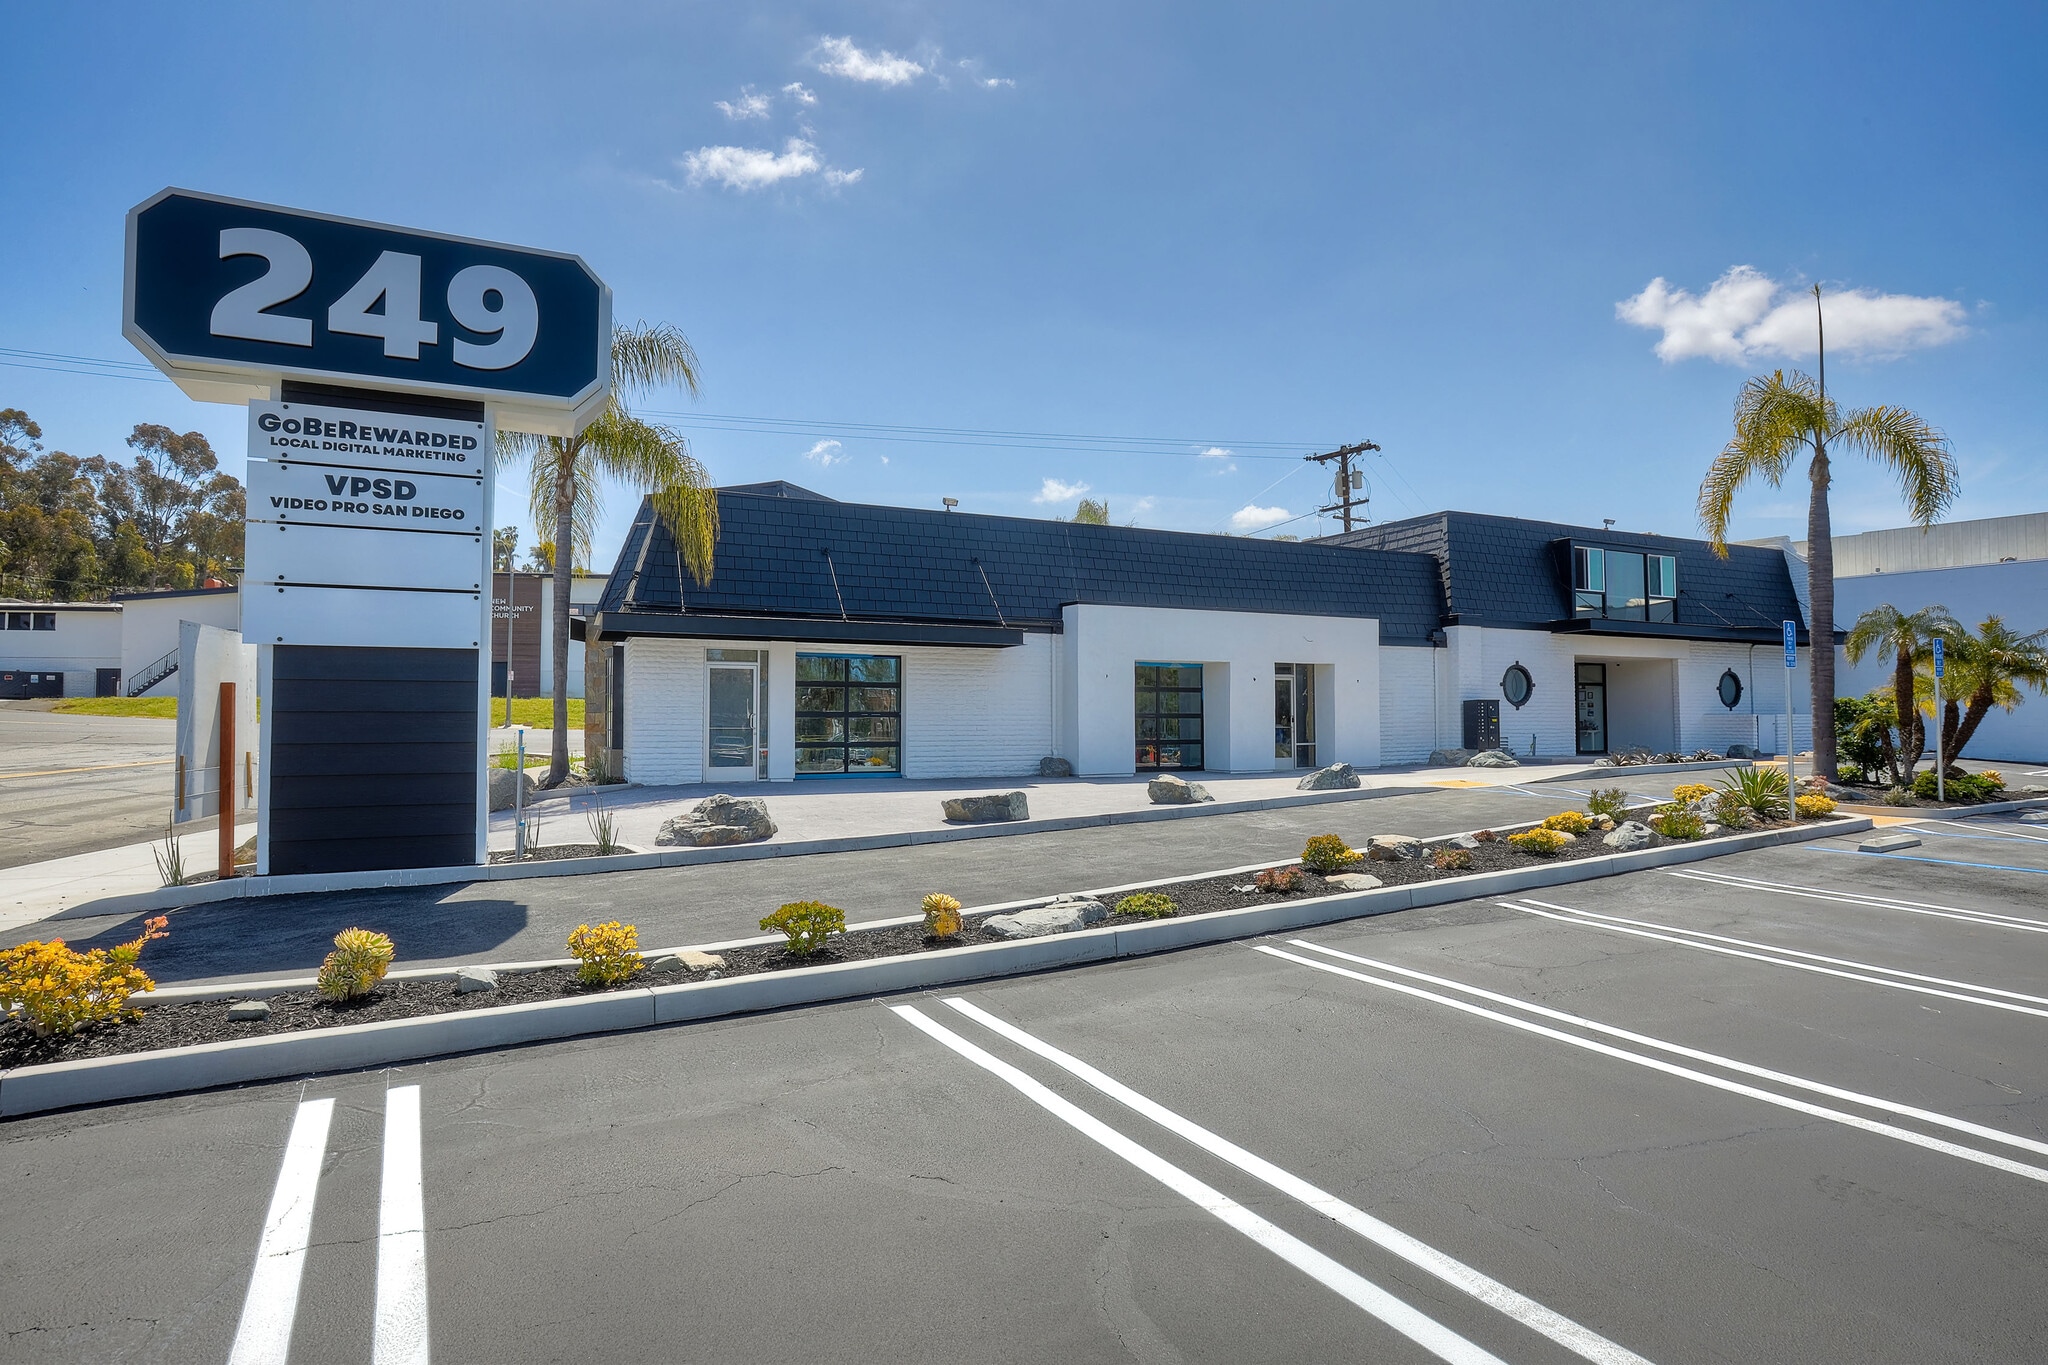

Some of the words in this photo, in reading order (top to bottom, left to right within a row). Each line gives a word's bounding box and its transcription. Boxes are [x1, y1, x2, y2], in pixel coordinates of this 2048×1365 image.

[209, 227, 540, 371] 249
[270, 436, 319, 449] LOCAL
[322, 441, 380, 455] DIGITAL
[383, 446, 466, 462] MARKETING
[325, 474, 417, 500] VPSD
[270, 496, 328, 511] VIDEO
[332, 501, 369, 514] PRO
[372, 503, 407, 517] SAN
[412, 506, 465, 520] DIEGO
